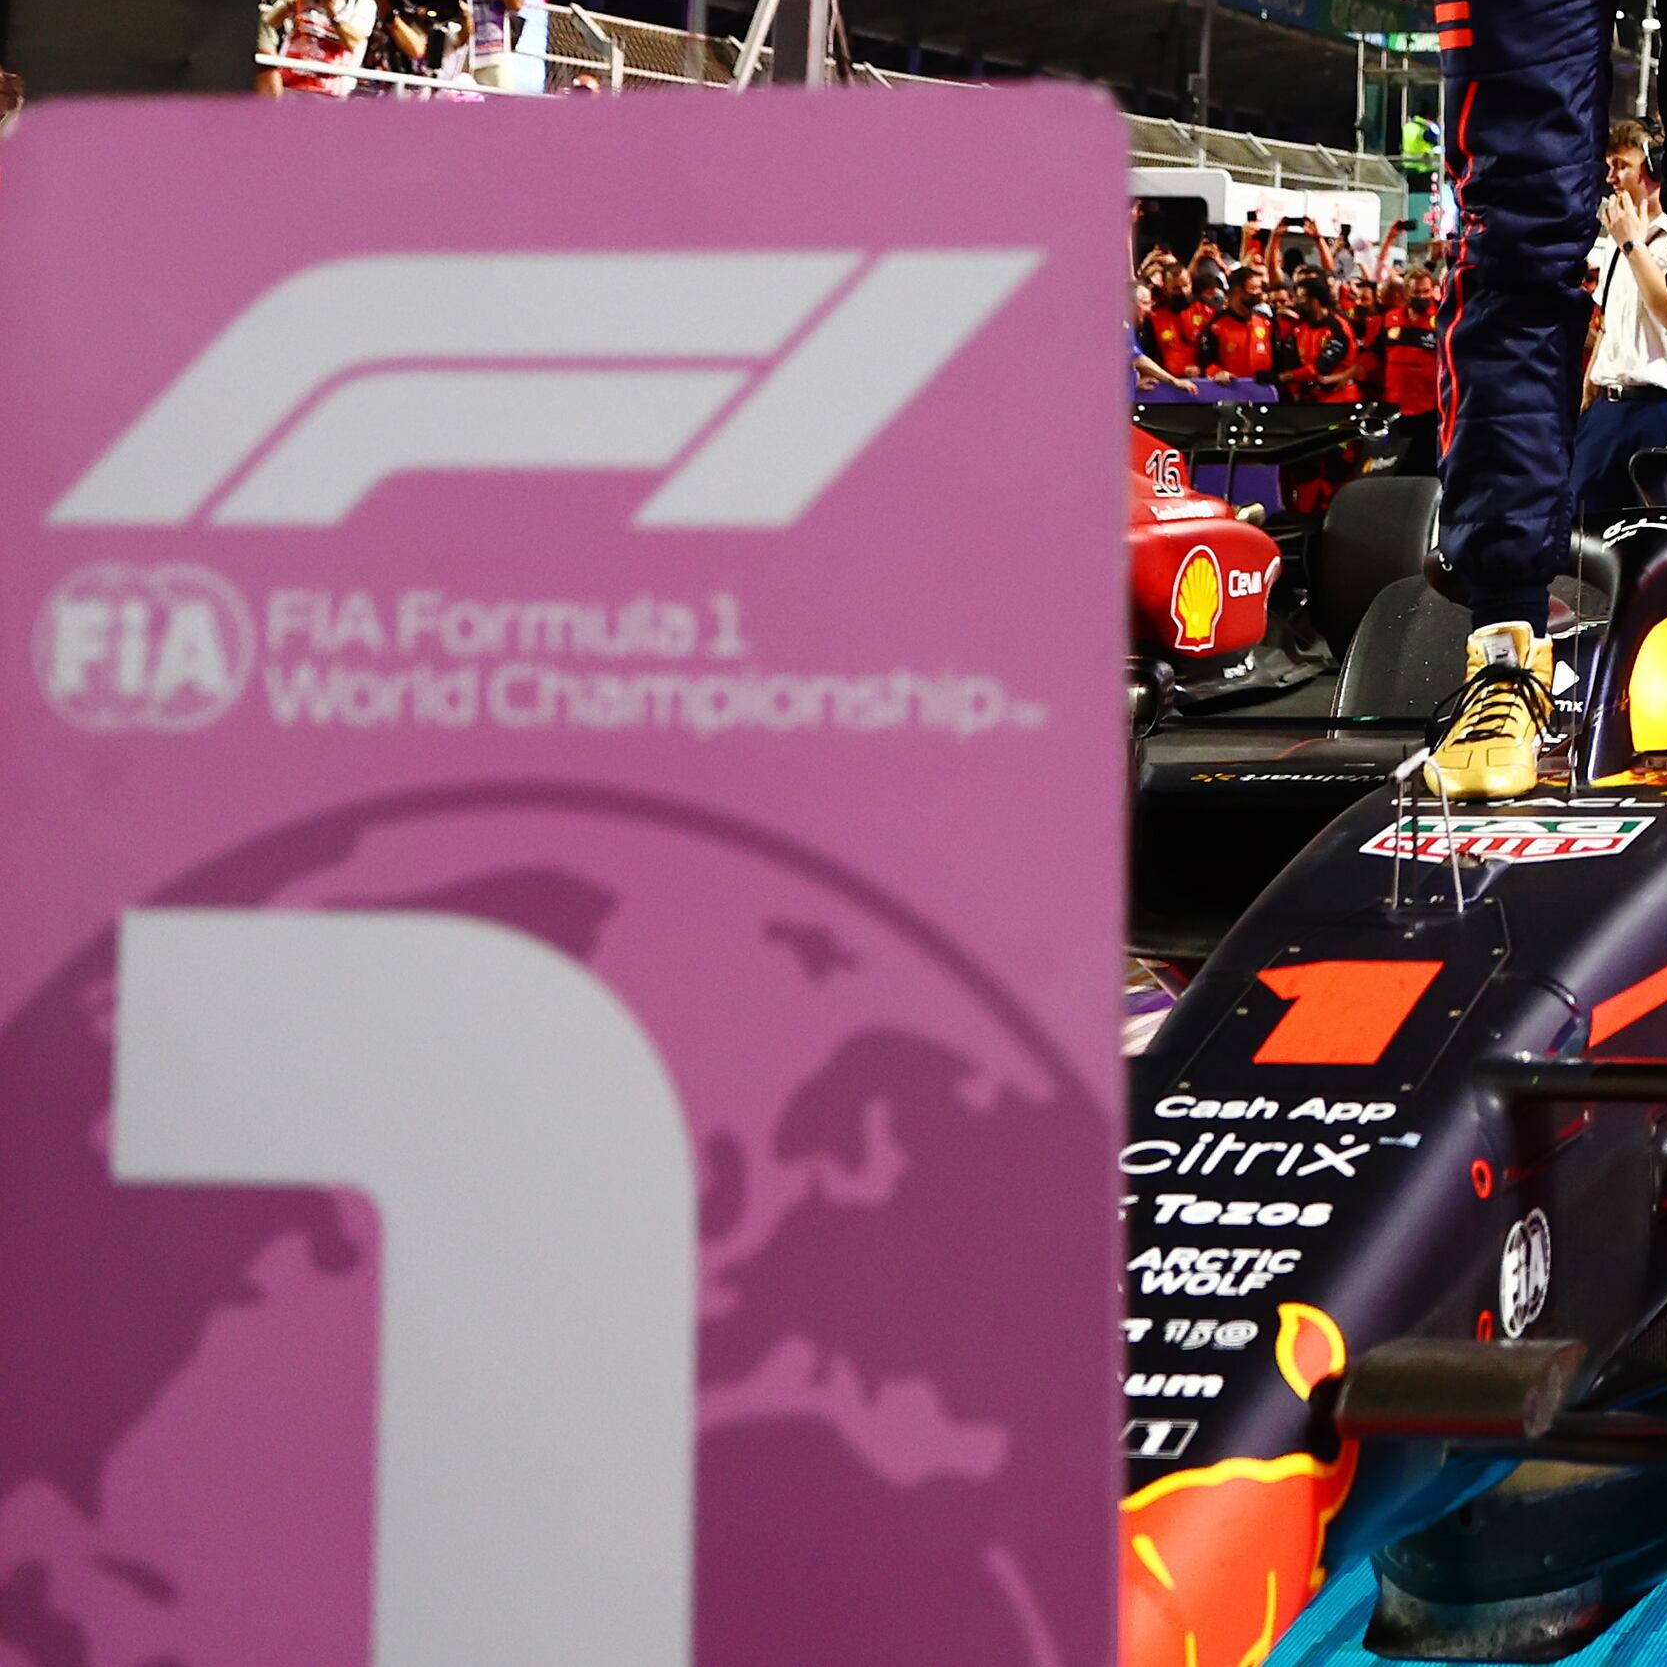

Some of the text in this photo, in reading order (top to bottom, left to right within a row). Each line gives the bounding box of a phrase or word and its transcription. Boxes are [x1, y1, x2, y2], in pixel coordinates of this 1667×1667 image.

[1145, 448, 1186, 497] 16
[268, 589, 748, 659] FIA Formula 1
[48, 593, 230, 703] FIA
[266, 663, 1000, 741] World Championship
[1252, 960, 1445, 1065] 1
[1154, 1094, 1397, 1124] Cash App
[1153, 1193, 1334, 1227] Tezos
[1127, 1246, 1302, 1274] ARCTIC
[1140, 1269, 1275, 1297] WOLF
[1121, 1372, 1224, 1398] um
